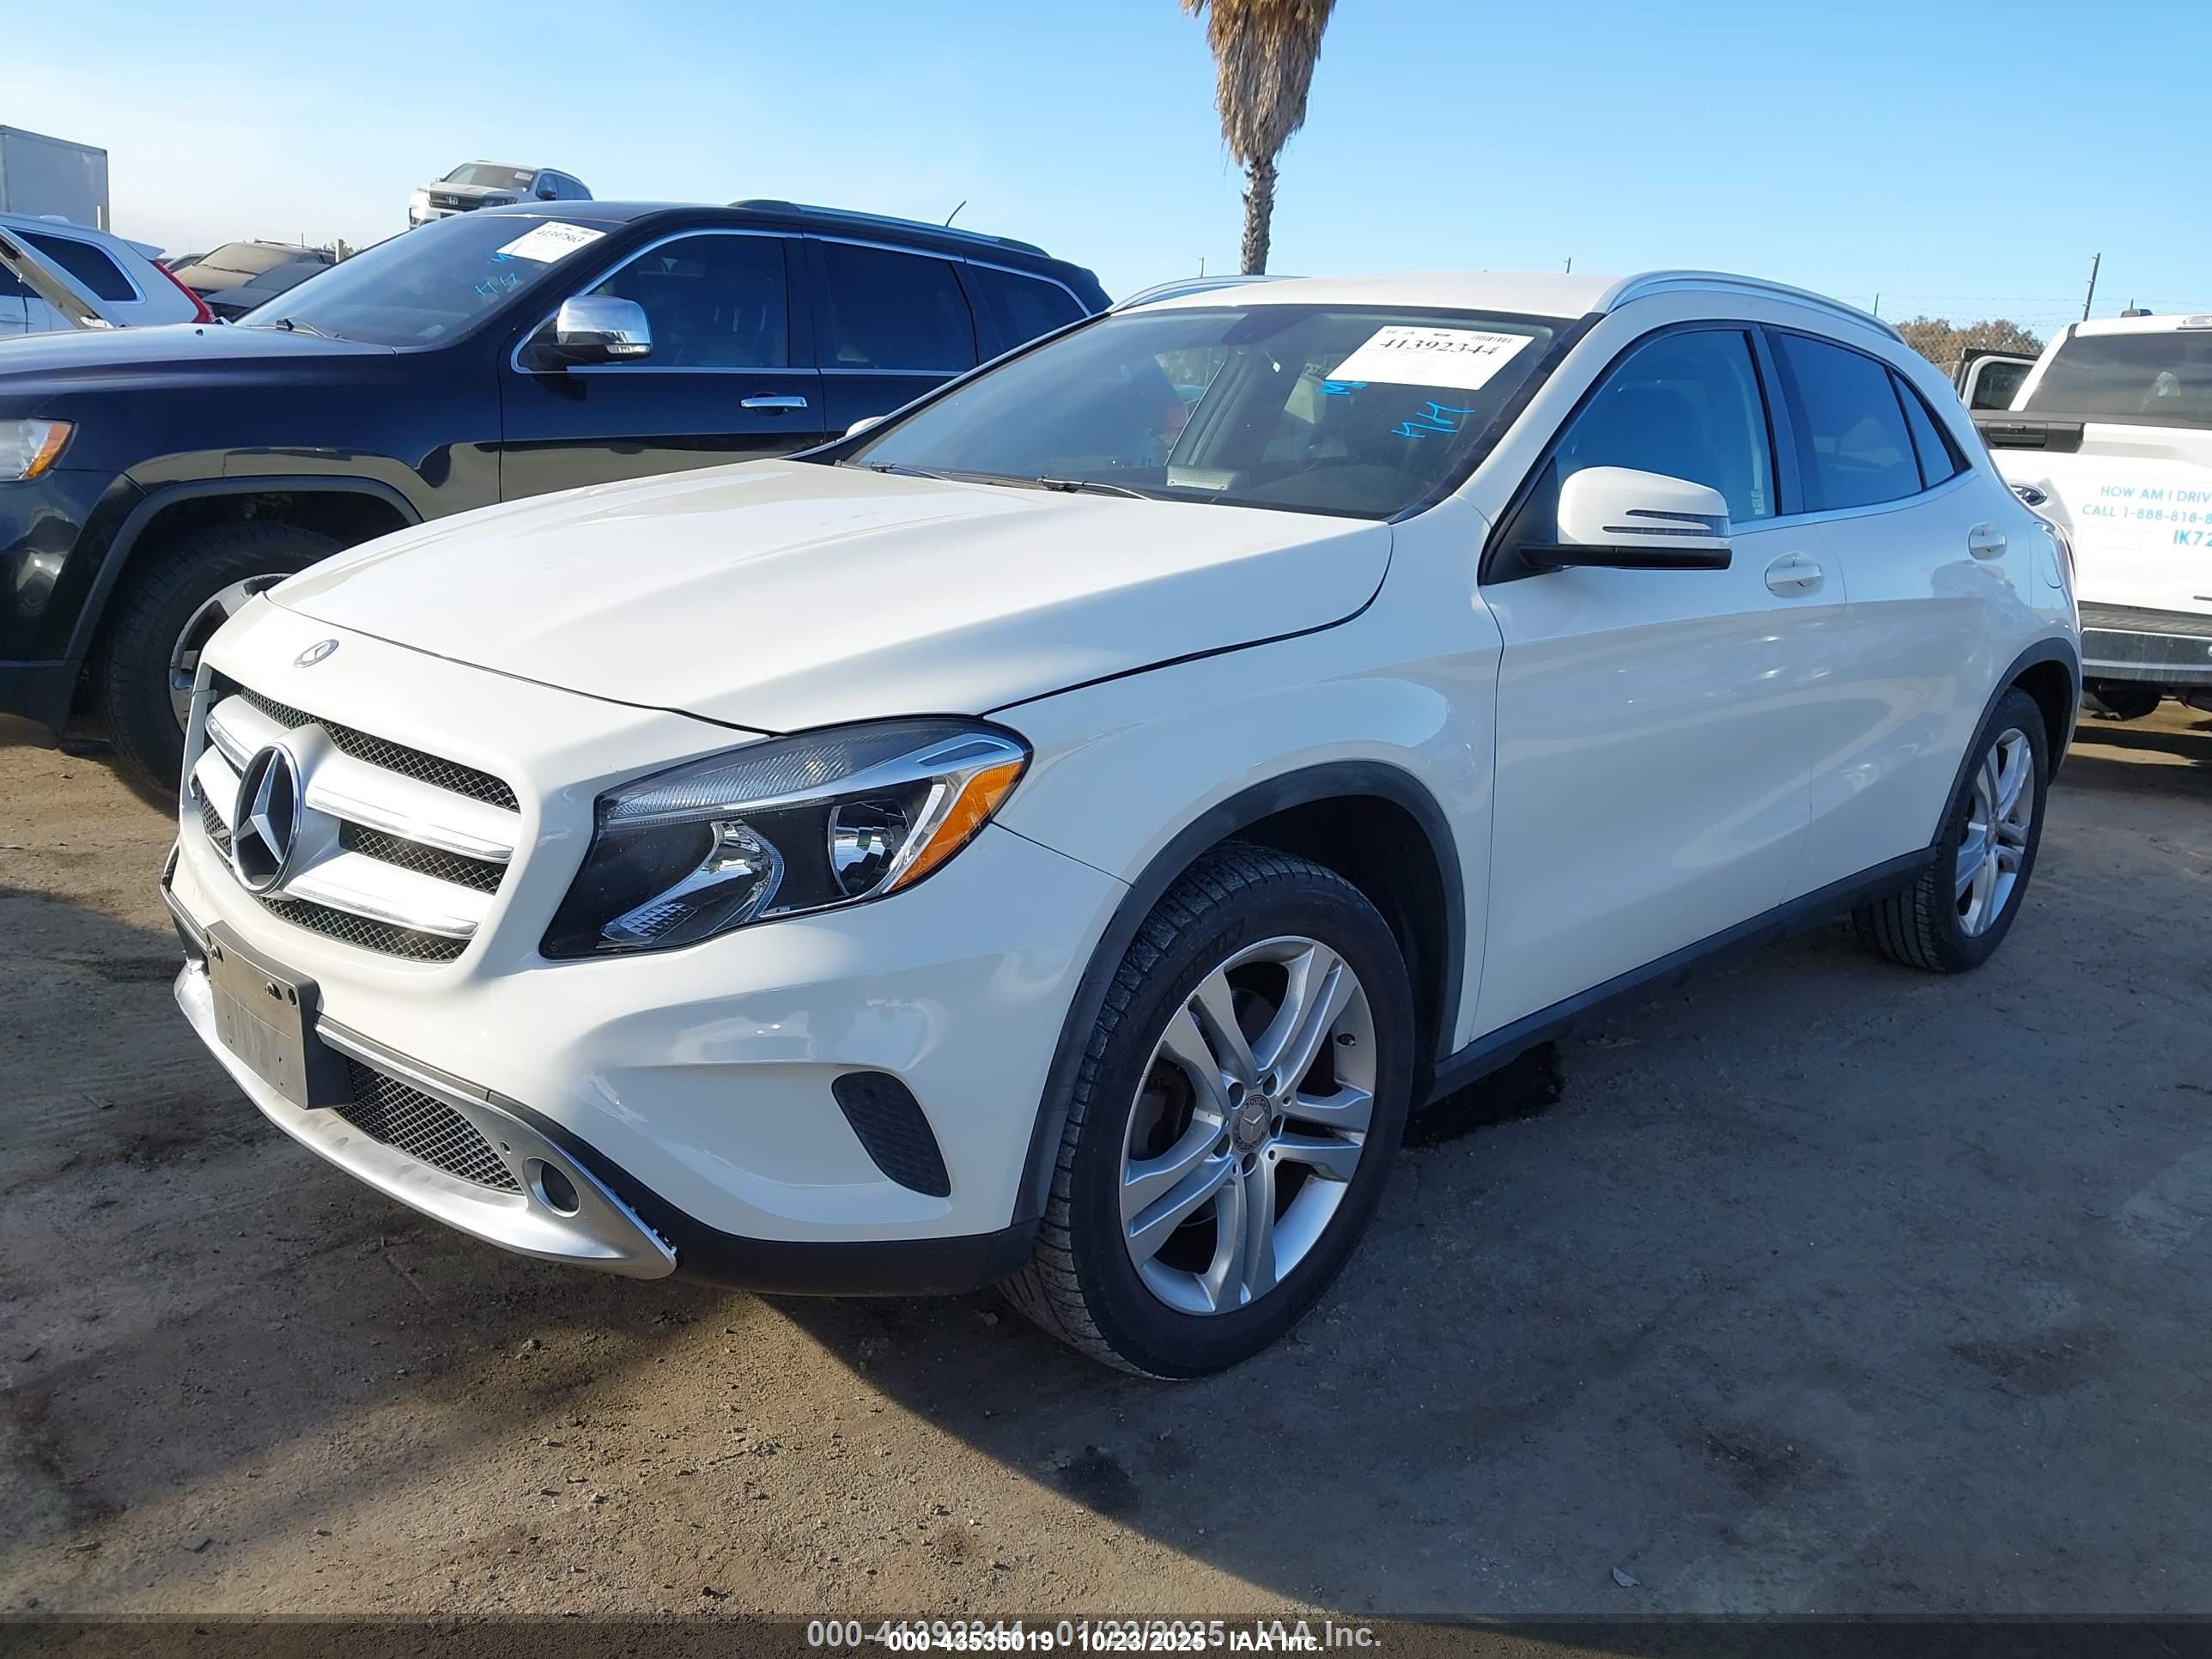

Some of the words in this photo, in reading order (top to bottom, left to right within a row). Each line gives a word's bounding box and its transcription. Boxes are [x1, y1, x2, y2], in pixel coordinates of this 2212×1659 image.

[1379, 338, 1500, 356] 41392344
[2100, 485, 2135, 498] HOW
[2140, 488, 2164, 501] AM
[2168, 489, 2172, 501] I
[2176, 489, 2212, 504] DRIV
[2081, 504, 2116, 517] CALL
